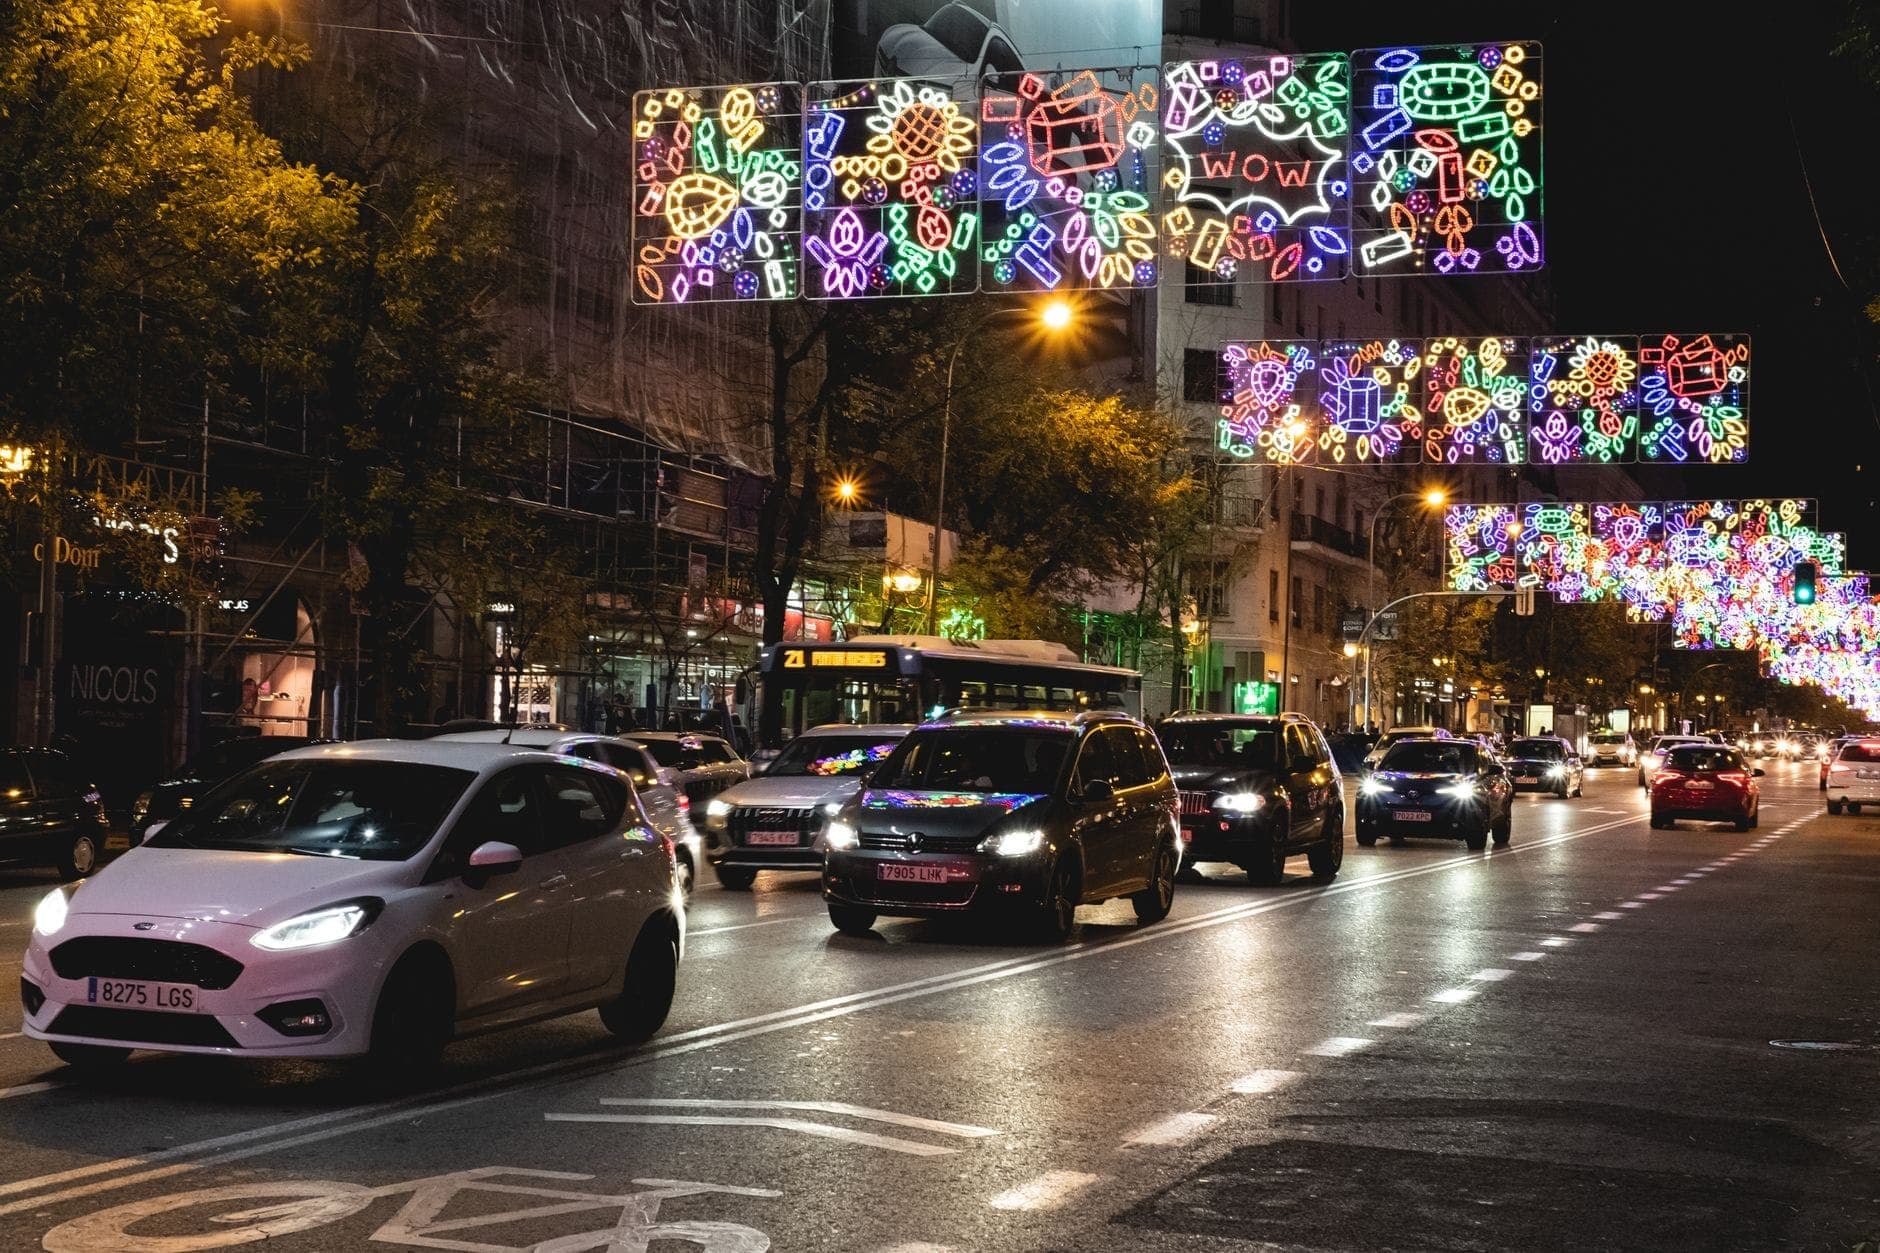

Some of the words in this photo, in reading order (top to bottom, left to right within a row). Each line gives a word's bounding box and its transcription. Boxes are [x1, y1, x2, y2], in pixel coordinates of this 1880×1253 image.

[1199, 149, 1311, 188] WOW
[71, 663, 158, 704] NICOLS
[886, 866, 916, 880] 7905
[102, 982, 148, 1005] 8275
[157, 986, 194, 1009] LGS
